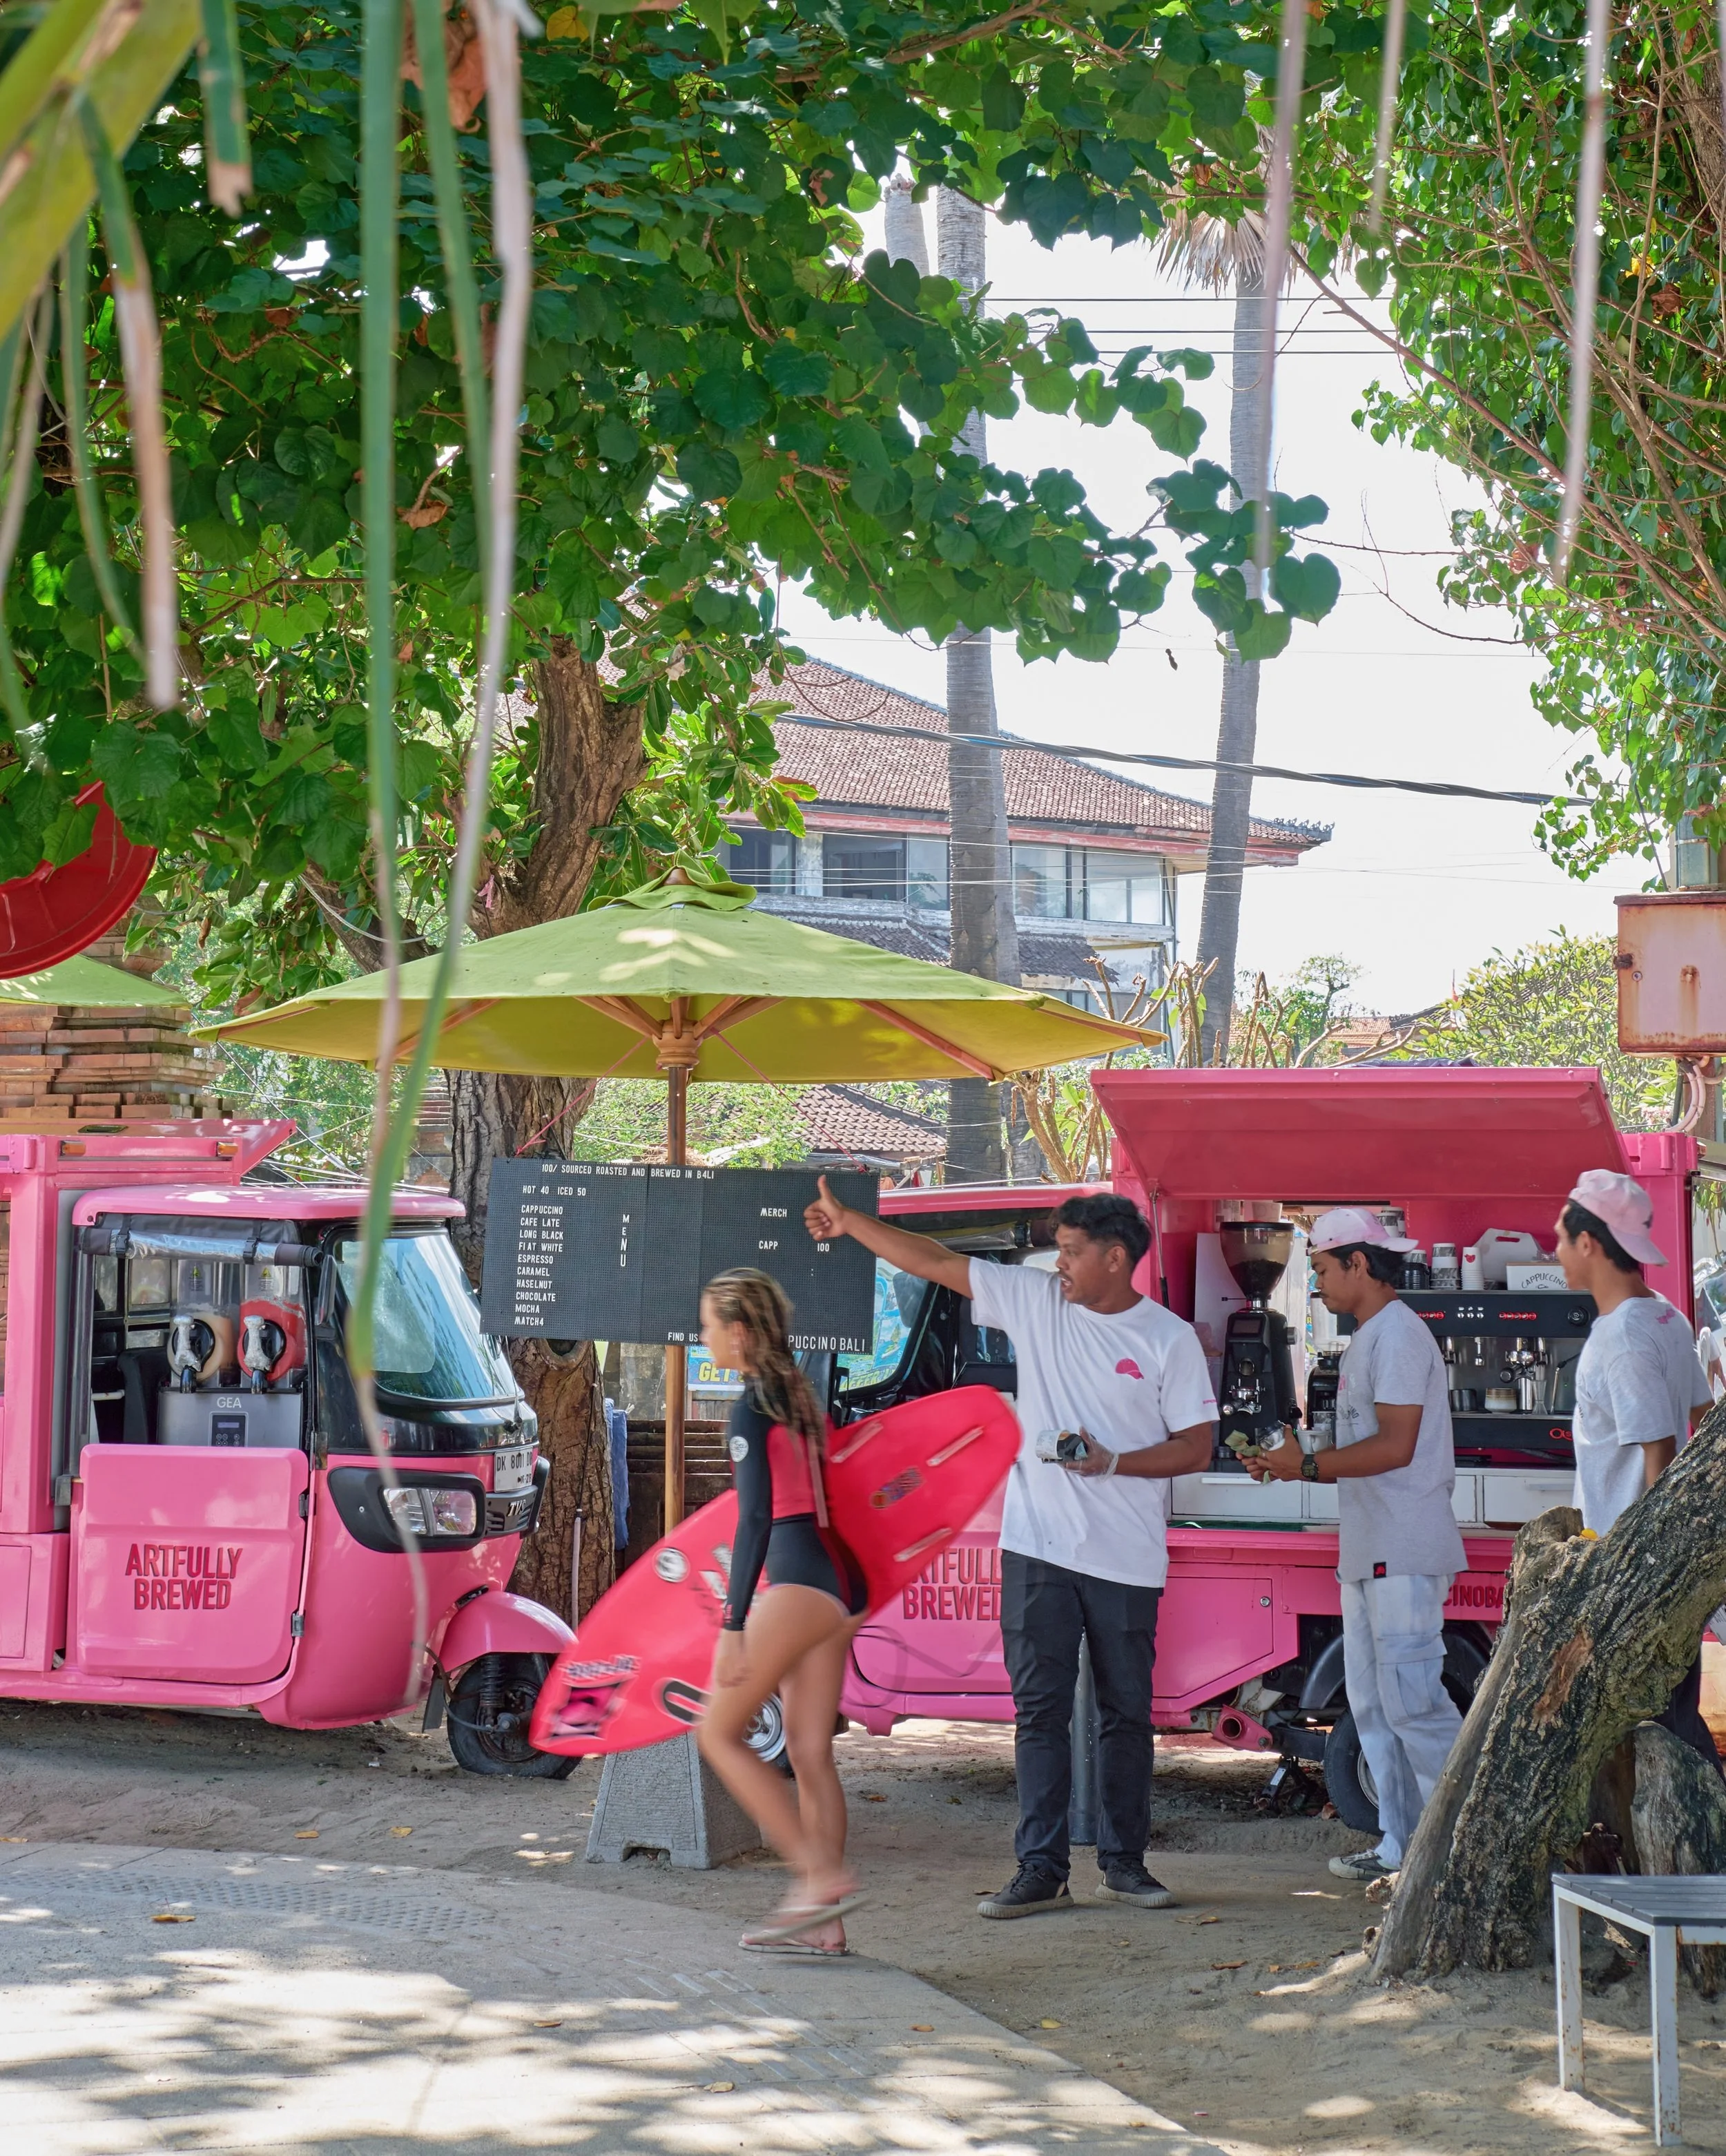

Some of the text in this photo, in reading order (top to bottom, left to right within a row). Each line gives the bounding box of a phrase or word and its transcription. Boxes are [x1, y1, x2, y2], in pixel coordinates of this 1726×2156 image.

[561, 1164, 592, 1175] SOURCED
[595, 1166, 628, 1176] ROASTED
[631, 1167, 646, 1177] AND
[650, 1168, 681, 1178] BREWED
[685, 1169, 692, 1179] IN
[522, 1184, 586, 1196] HOT 40 ICED 50
[521, 1204, 563, 1215] CAPPUCCINO
[520, 1217, 561, 1228] CAFE LATE
[519, 1229, 564, 1240] LONG BLACK
[541, 1242, 563, 1253] WHITE
[759, 1240, 830, 1252] CAPP 100
[517, 1253, 554, 1265] ESPRESSO
[516, 1267, 550, 1277] CARAMEL
[516, 1279, 553, 1289] HASELNUT
[1521, 1273, 1568, 1289] CAPPUCCINO
[516, 1291, 556, 1302] CHOCOLATE
[515, 1304, 540, 1313] MOCHA
[668, 1331, 685, 1342] FIND
[689, 1333, 699, 1342] US
[216, 1396, 242, 1409] GEA
[496, 1456, 506, 1472] DK
[125, 1543, 243, 1579] ARTFULLY
[134, 1578, 232, 1610] BREWED
